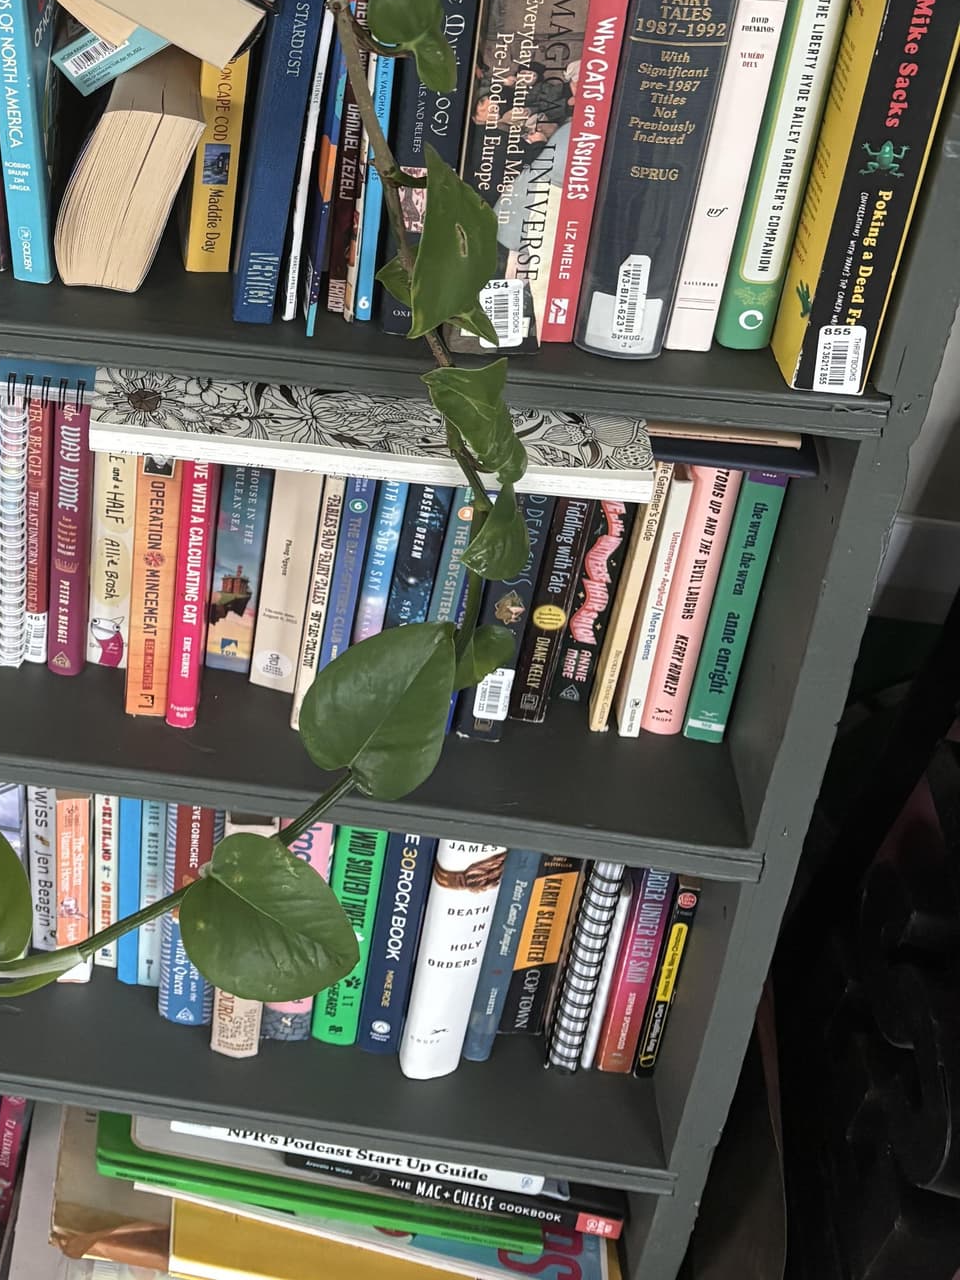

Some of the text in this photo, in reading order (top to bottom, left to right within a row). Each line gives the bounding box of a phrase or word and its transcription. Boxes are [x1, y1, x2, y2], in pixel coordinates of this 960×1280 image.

[0, 13, 12, 32] OF
[589, 17, 618, 54] Why
[635, 19, 726, 38] 1987-1992
[660, 5, 712, 22] TALES
[1, 35, 16, 81] NORTH
[582, 58, 608, 100] CATS
[584, 106, 597, 127] are
[885, 62, 920, 129] Sacks
[6, 87, 21, 149] AMERICA
[201, 188, 224, 252] Maddie Day
[559, 220, 578, 280] LIZ MIELE
[143, 481, 165, 636] OPERATION MINCEMEAT
[664, 634, 689, 697] KERRY HOWLEY
[709, 612, 740, 695] anne enright
[35, 851, 53, 926] Jen Beagin
[447, 905, 490, 917] DEATH
[473, 922, 486, 932] IN
[428, 957, 478, 968] ORDERS
[451, 940, 482, 951] HOLY
[284, 1137, 352, 1159] Podcast
[356, 1150, 402, 1167] Start
[407, 1159, 431, 1174] Up
[435, 1163, 488, 1181] Guide
[390, 1178, 412, 1191] THE
[417, 1183, 442, 1200] MAC
[455, 1188, 494, 1210] CHEESE
[499, 1203, 561, 1222] COOKBOOK
